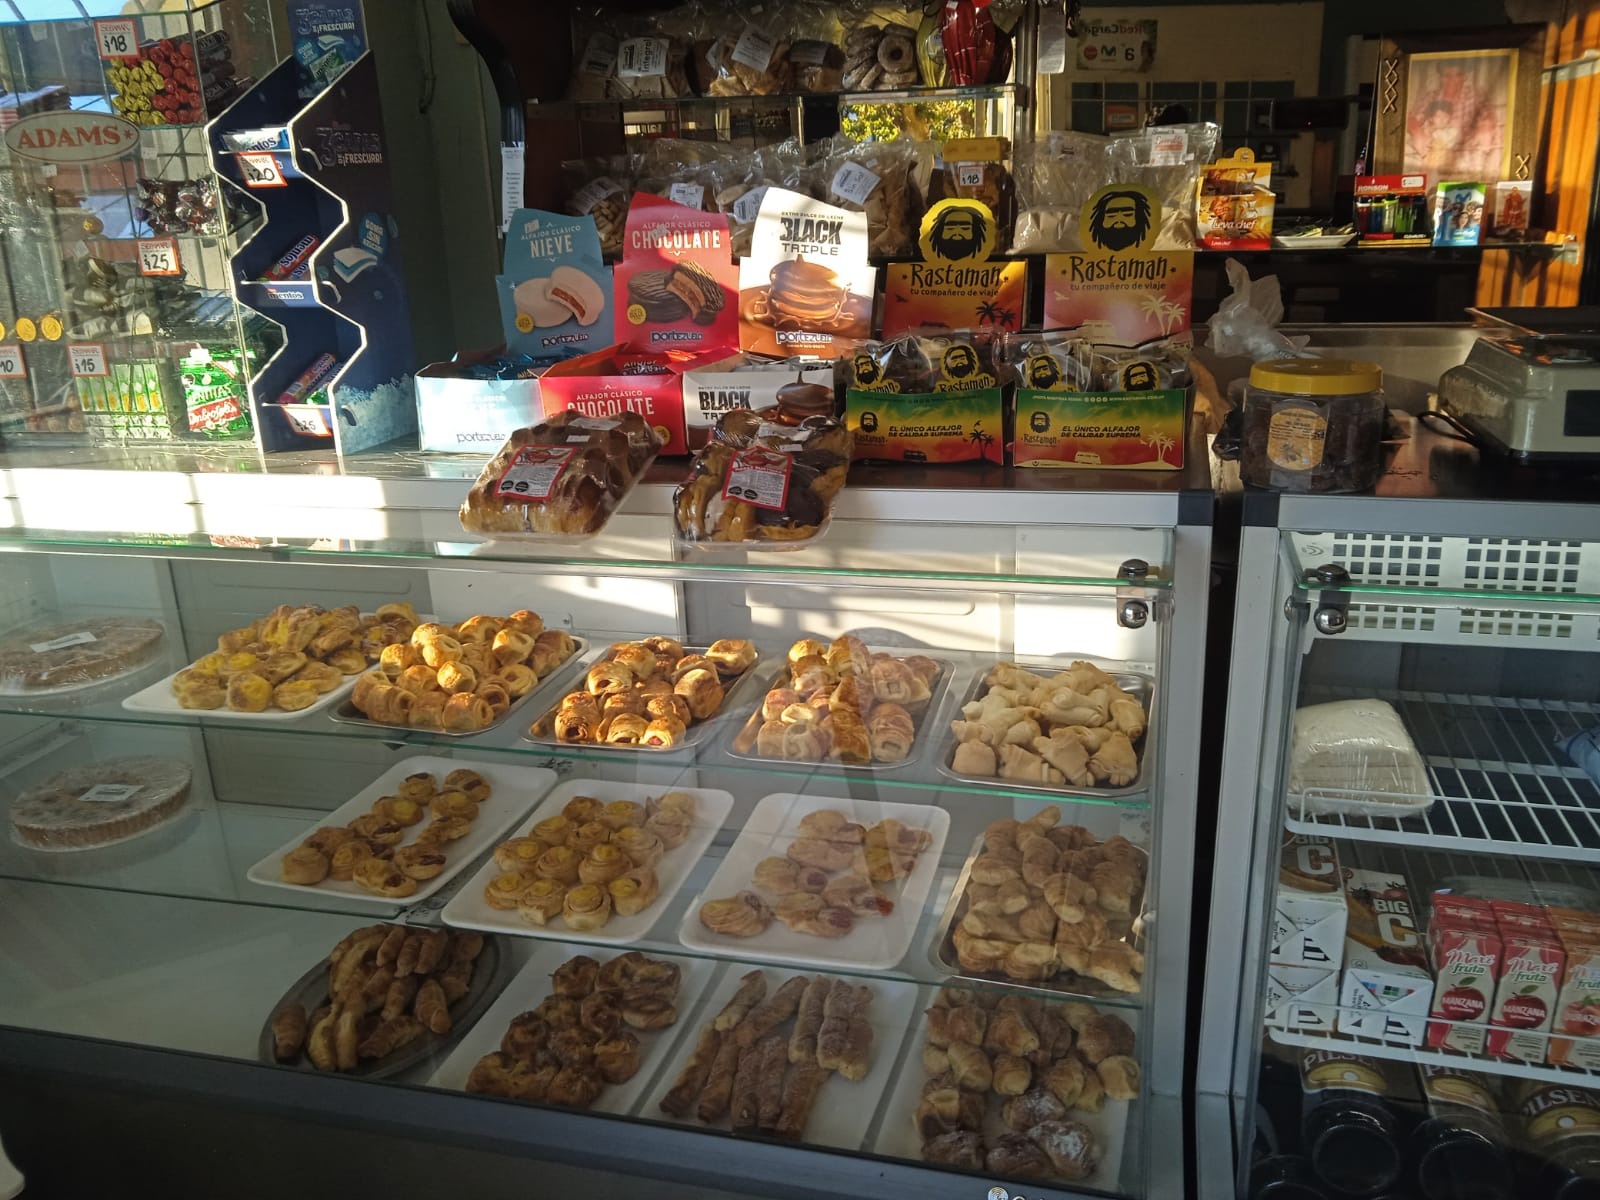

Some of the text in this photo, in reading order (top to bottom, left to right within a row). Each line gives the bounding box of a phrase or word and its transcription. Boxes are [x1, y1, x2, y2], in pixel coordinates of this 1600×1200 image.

[18, 125, 122, 149] ADAMS
[780, 217, 844, 246] BLACK
[631, 229, 721, 249] CHOCOLATE
[530, 234, 574, 259] NIEVE
[782, 242, 839, 256] TRIPLE
[910, 263, 1001, 289] Rastaman
[1069, 255, 1168, 284] Rastaman
[910, 287, 999, 298] tu compañero de viaje
[1070, 279, 1166, 292] tu compañero de viaje
[938, 376, 990, 393] Rastaman
[577, 389, 643, 402] ALFAJOR CLÁSICO
[699, 390, 752, 411] BLACK
[567, 397, 655, 419] CHOCOLATE
[888, 424, 963, 433] EL ÚNICO ALFAJOR
[930, 430, 964, 438] SUPREMA
[1062, 424, 1141, 433] EL ÚNICO ALFAJOR
[1105, 431, 1142, 439] SUPREMA
[1295, 836, 1330, 845] BIG
[1295, 845, 1335, 876] C
[1373, 899, 1410, 914] BIG
[1377, 912, 1419, 947] C
[1452, 963, 1486, 975] fruta
[1514, 971, 1548, 983] fruta
[1577, 979, 1600, 990] frut
